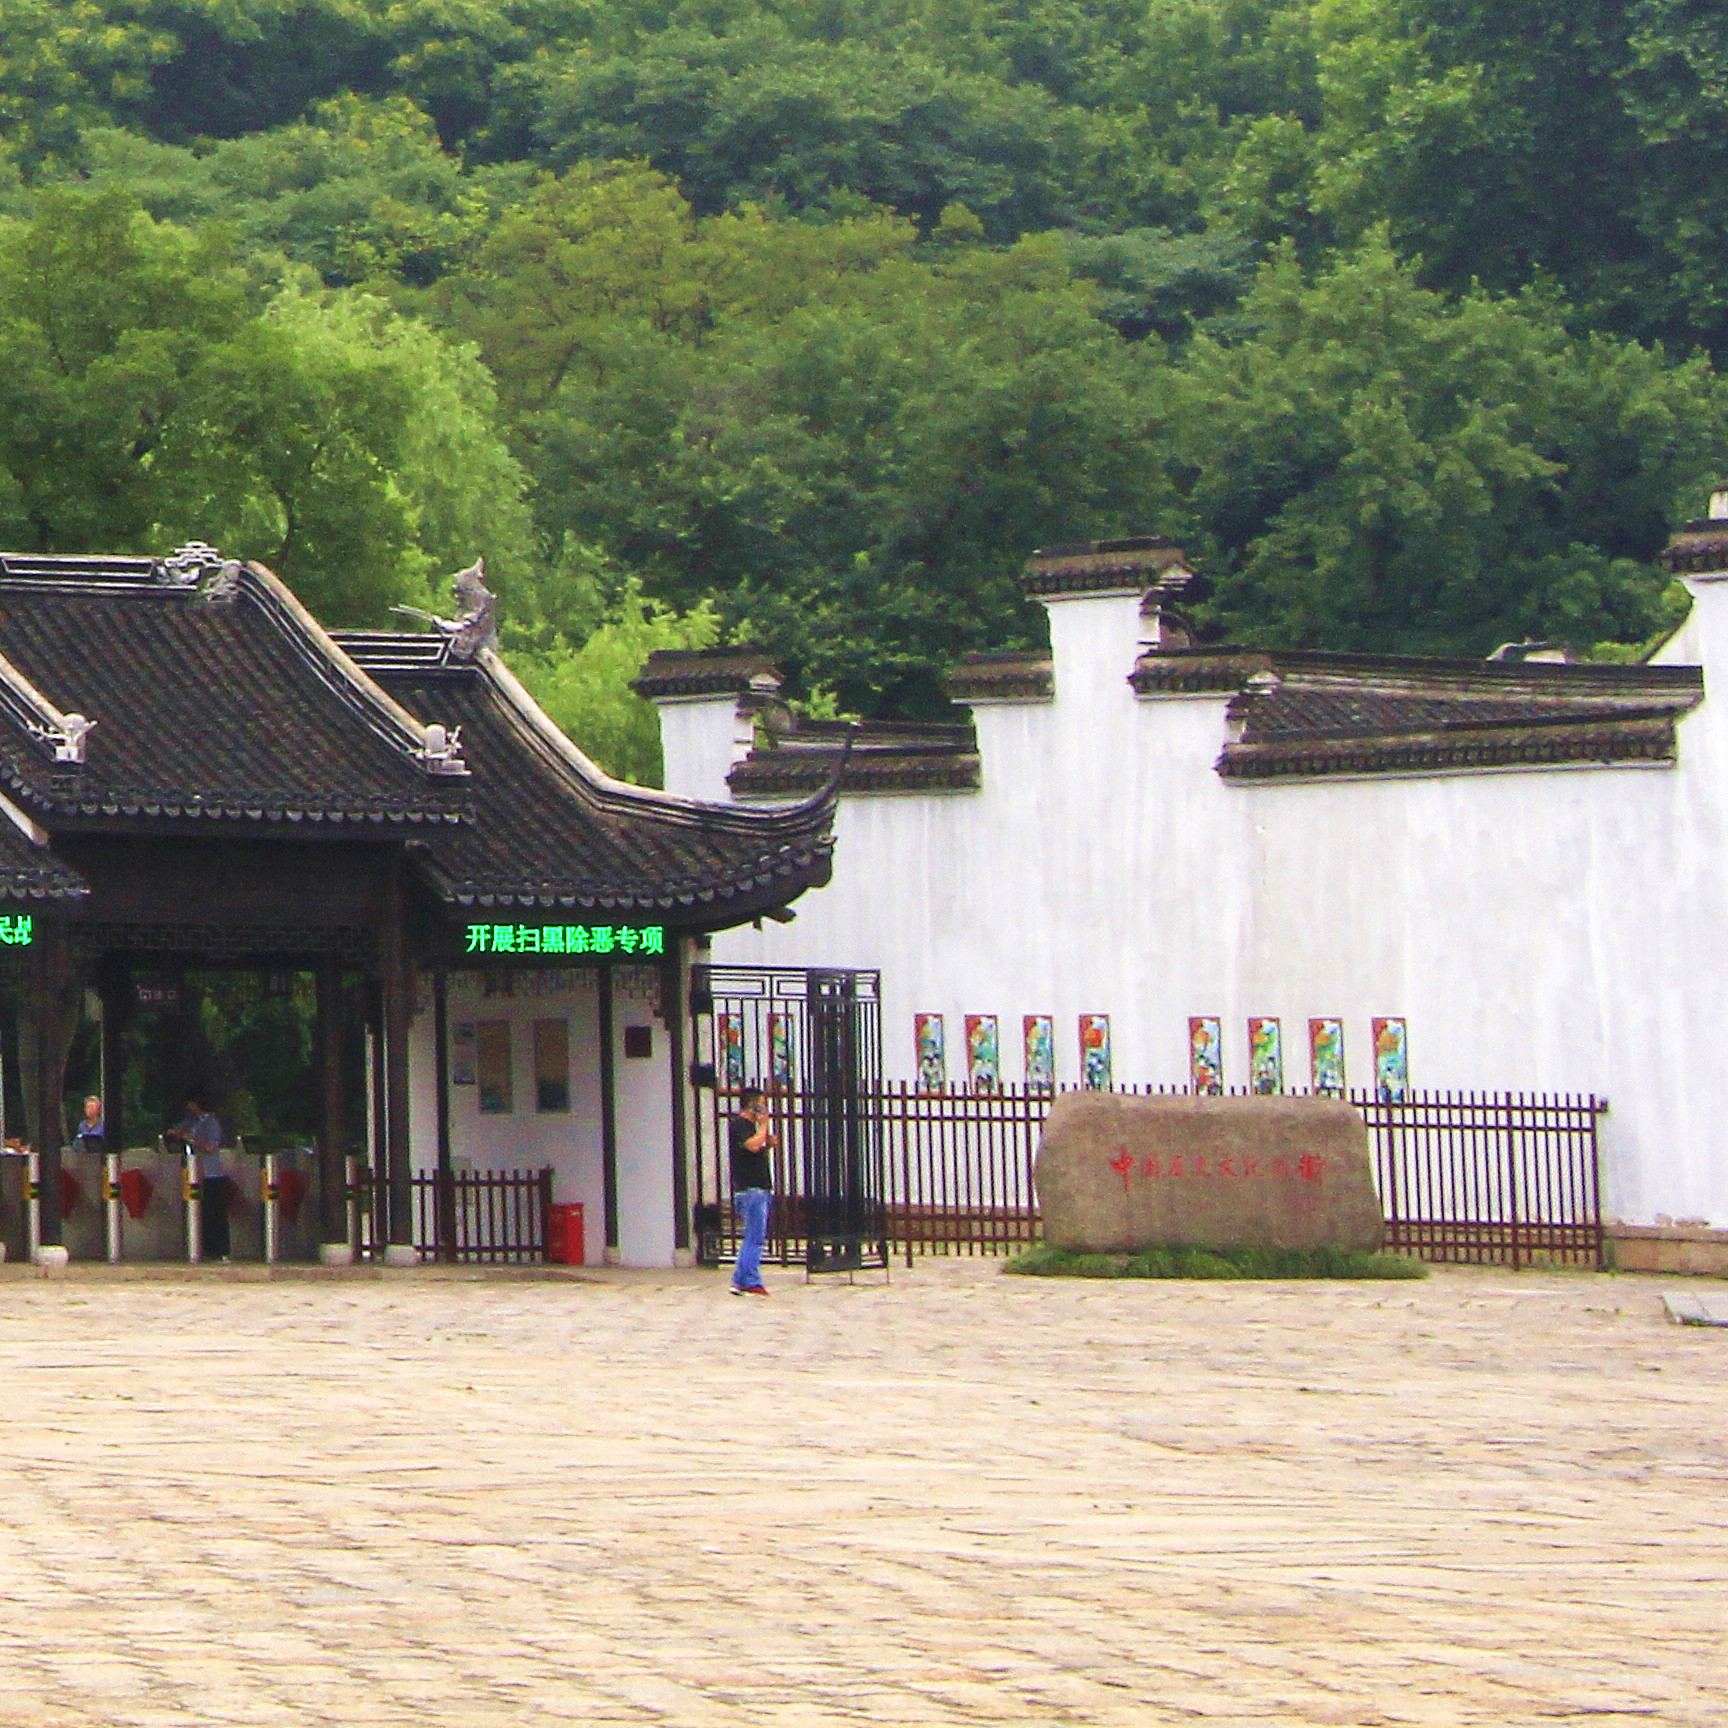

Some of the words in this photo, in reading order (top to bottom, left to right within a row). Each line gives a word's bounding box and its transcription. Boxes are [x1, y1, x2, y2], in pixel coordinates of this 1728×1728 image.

[465, 924, 665, 954] 开展扫黑除恶专项
